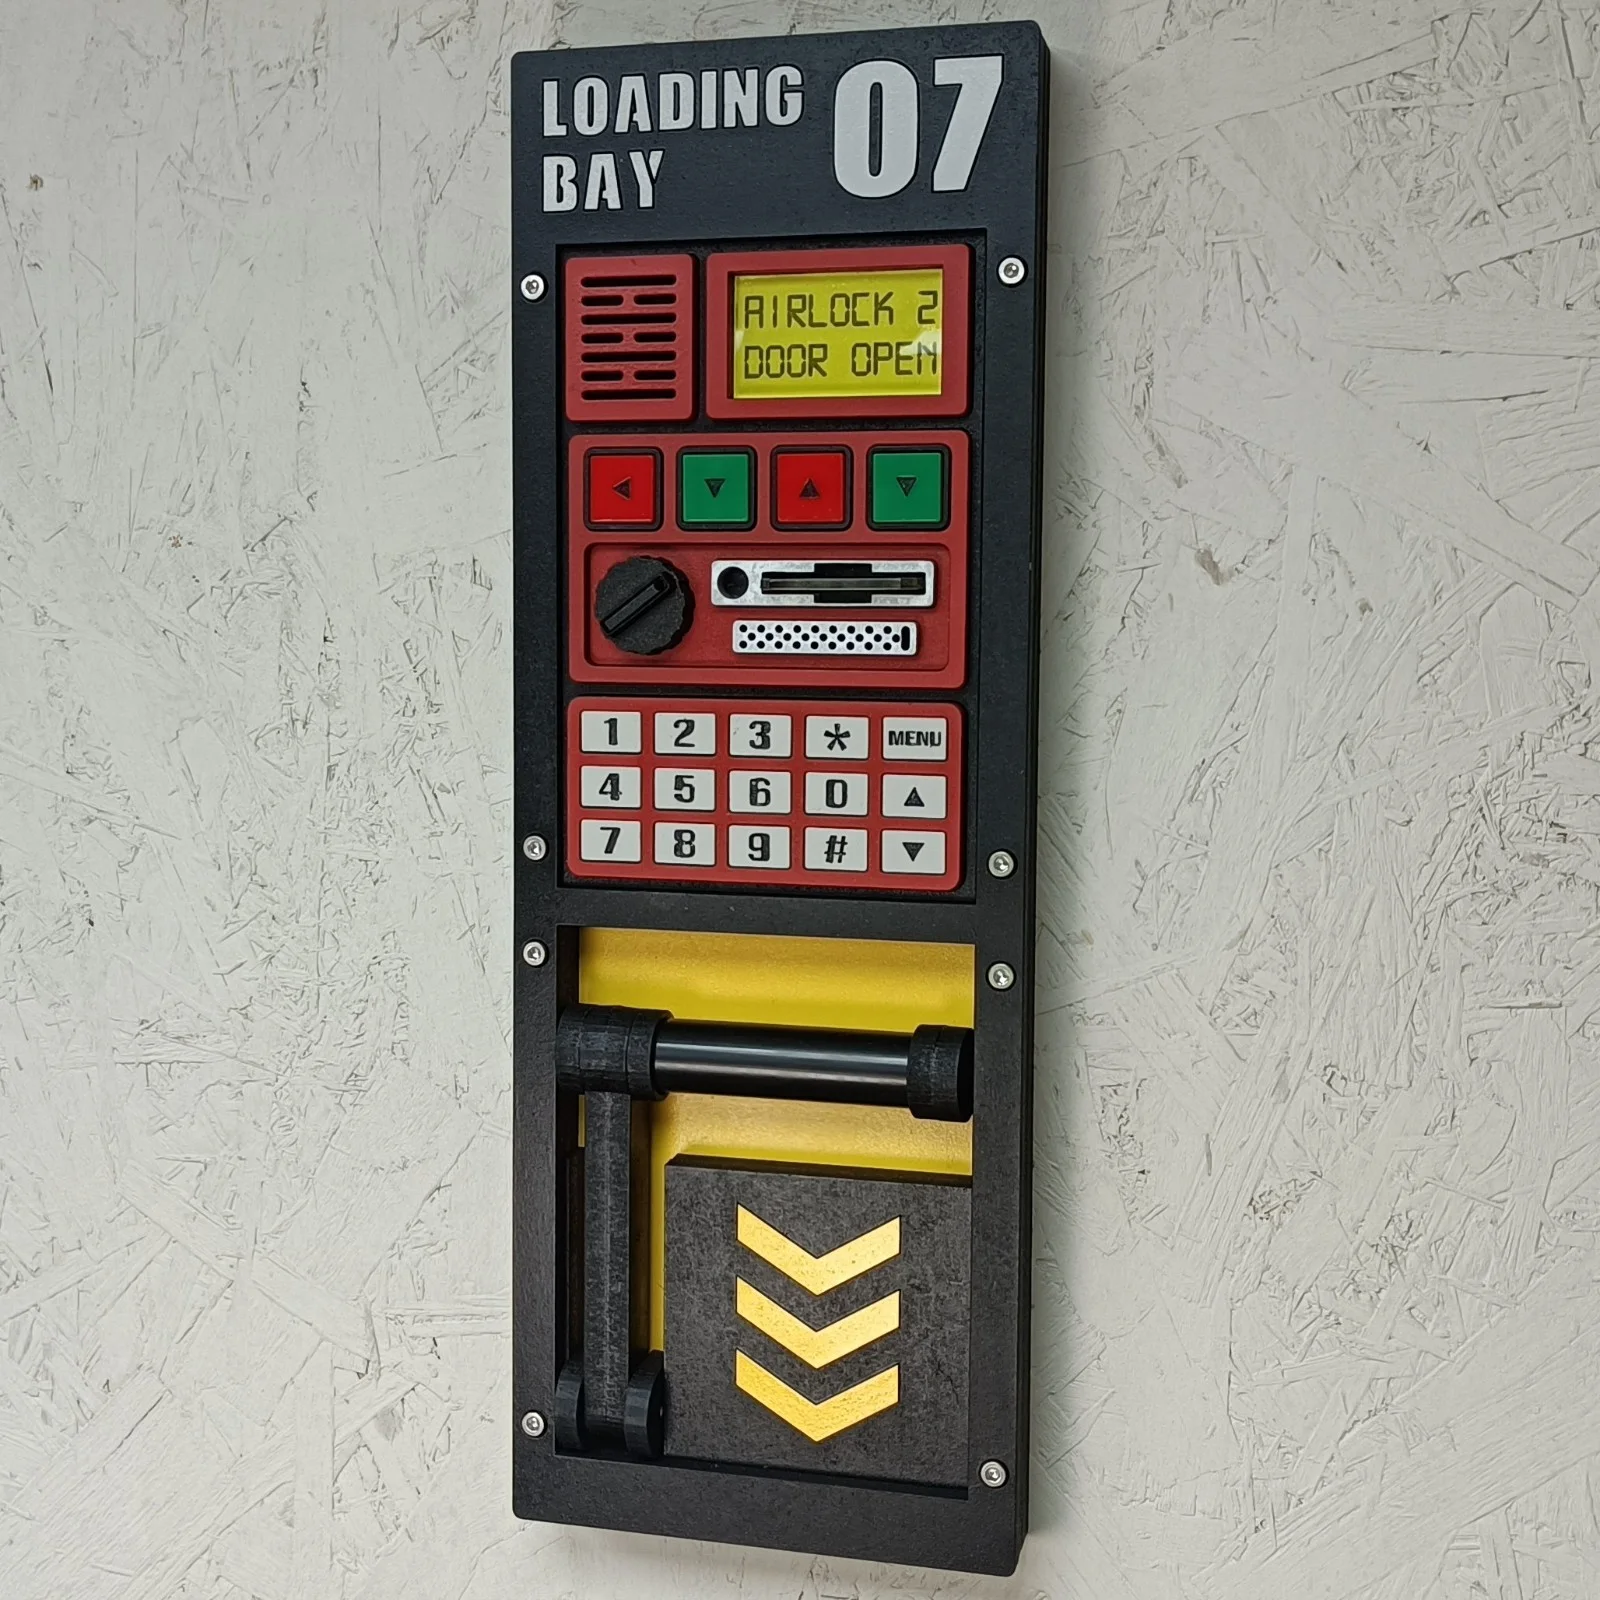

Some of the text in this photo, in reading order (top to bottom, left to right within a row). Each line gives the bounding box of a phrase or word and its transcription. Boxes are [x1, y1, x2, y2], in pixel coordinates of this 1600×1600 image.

[543, 65, 803, 137] LOADING
[834, 55, 1003, 198] 07
[543, 150, 664, 212] BAY
[744, 290, 938, 330] AIRLOCK 2
[744, 342, 938, 379] DOOR OPEN
[604, 718, 618, 745] 1
[674, 719, 695, 747] 2
[749, 721, 771, 749] 3
[889, 731, 941, 747] MENU
[599, 773, 622, 801] 4
[674, 775, 695, 803] 5
[750, 778, 770, 806] 6
[826, 779, 847, 808] 0
[600, 827, 620, 854] 7
[674, 830, 695, 858] 8
[748, 833, 770, 861] 9
